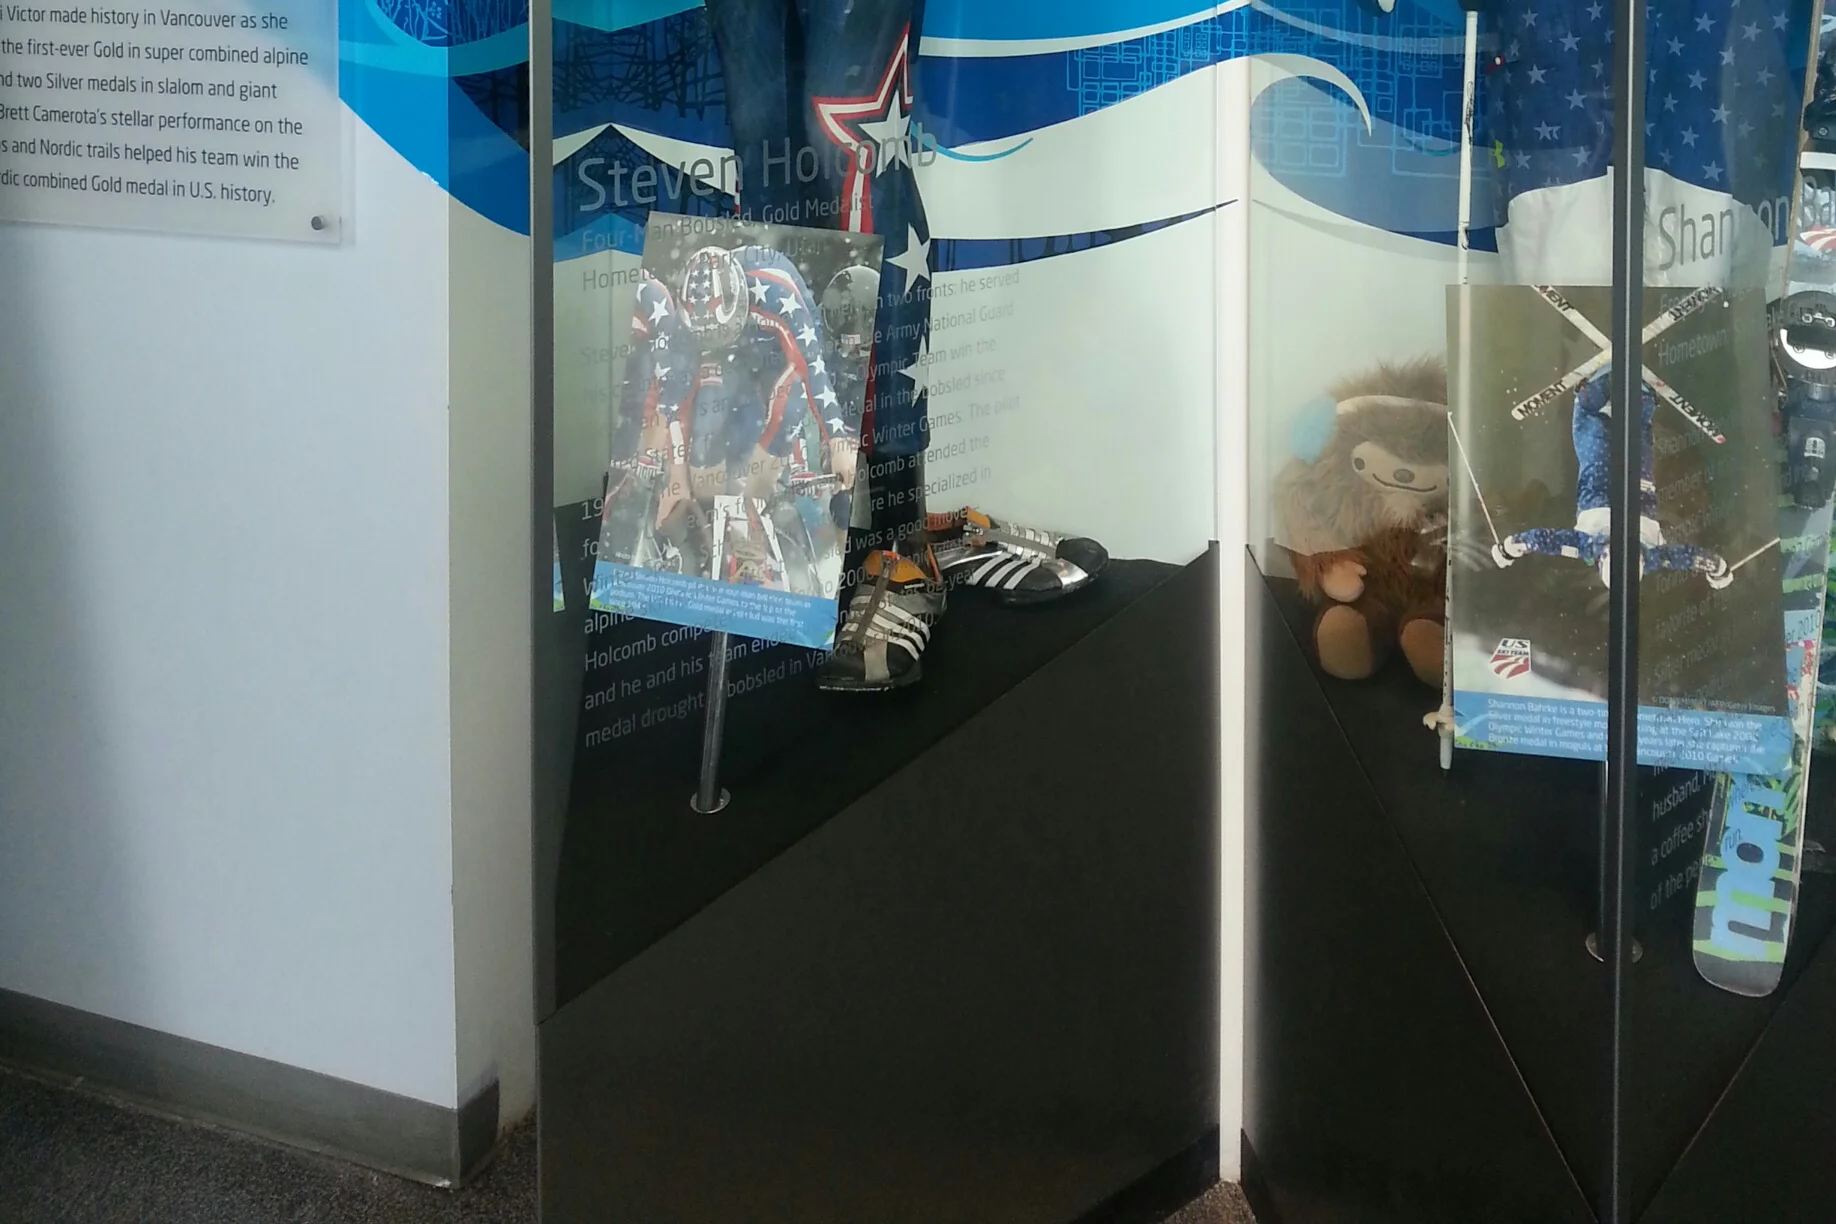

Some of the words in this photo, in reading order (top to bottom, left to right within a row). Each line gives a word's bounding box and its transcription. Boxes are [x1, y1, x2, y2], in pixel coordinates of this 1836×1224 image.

[7, 6, 45, 22] Victor
[50, 8, 87, 23] made
[92, 8, 139, 29] history
[144, 10, 155, 25] in
[161, 10, 236, 27] Vancouver
[240, 15, 256, 28] as
[262, 13, 287, 29] she
[1, 39, 23, 54] the
[28, 39, 89, 56] first-ever
[94, 41, 123, 58] Gold
[129, 42, 140, 58] in
[145, 47, 184, 63] super
[189, 46, 258, 63] combined
[264, 48, 308, 67] alpine
[17, 74, 42, 88] two
[47, 73, 83, 90] Silver
[88, 76, 136, 92] medals
[142, 77, 153, 92] in
[158, 78, 203, 94] slalom
[208, 81, 234, 97] and
[240, 81, 276, 101] giant
[111, 110, 154, 127] stellar
[159, 113, 250, 132] performance
[255, 120, 272, 133] on
[278, 118, 302, 135] the
[12, 138, 36, 154] and
[41, 139, 82, 157] Nordic
[87, 143, 120, 159] trails
[125, 144, 172, 164] helped
[177, 147, 196, 163] his
[202, 150, 238, 165] team
[243, 151, 269, 167] win
[274, 153, 299, 170] the
[578, 152, 744, 213] Steven
[762, 122, 938, 188] Holcomb
[24, 173, 87, 190] combined
[92, 175, 121, 193] Gold
[126, 179, 168, 195] medal
[173, 180, 185, 196] in
[190, 182, 216, 198] U.S.
[221, 183, 274, 206] history.
[762, 199, 800, 224] Gold
[1658, 194, 1791, 273] Shanon
[959, 278, 977, 294] he
[978, 268, 1020, 291] served
[886, 320, 920, 345] Army
[922, 308, 976, 335] National
[1517, 380, 1568, 418] MOMENT
[871, 417, 917, 444] Winter
[968, 433, 990, 451] the
[887, 488, 906, 508] he
[907, 469, 979, 503] specialized
[979, 464, 993, 482] in
[852, 531, 884, 551] was
[885, 528, 896, 542] a
[896, 517, 930, 542] good
[584, 633, 658, 673] Holcomb
[1502, 639, 1530, 649] US
[583, 684, 616, 711] and
[619, 676, 642, 699] he
[646, 665, 677, 690] and
[680, 655, 704, 674] his
[584, 713, 637, 749] medal
[640, 692, 706, 728] drought
[726, 660, 786, 698] bobsled
[788, 658, 803, 674] in
[1487, 698, 1527, 712] Shannon
[1527, 702, 1558, 715] Bahrke
[1559, 704, 1568, 714] is
[1513, 713, 1541, 724] medal
[1552, 716, 1594, 728] freestyle
[1523, 725, 1553, 737] Winter
[1555, 727, 1585, 740] Games
[1586, 730, 1605, 741] and
[1520, 736, 1549, 747] medal
[1559, 739, 1592, 753] moguls
[1659, 821, 1696, 860] coffee
[1663, 873, 1685, 897] the
